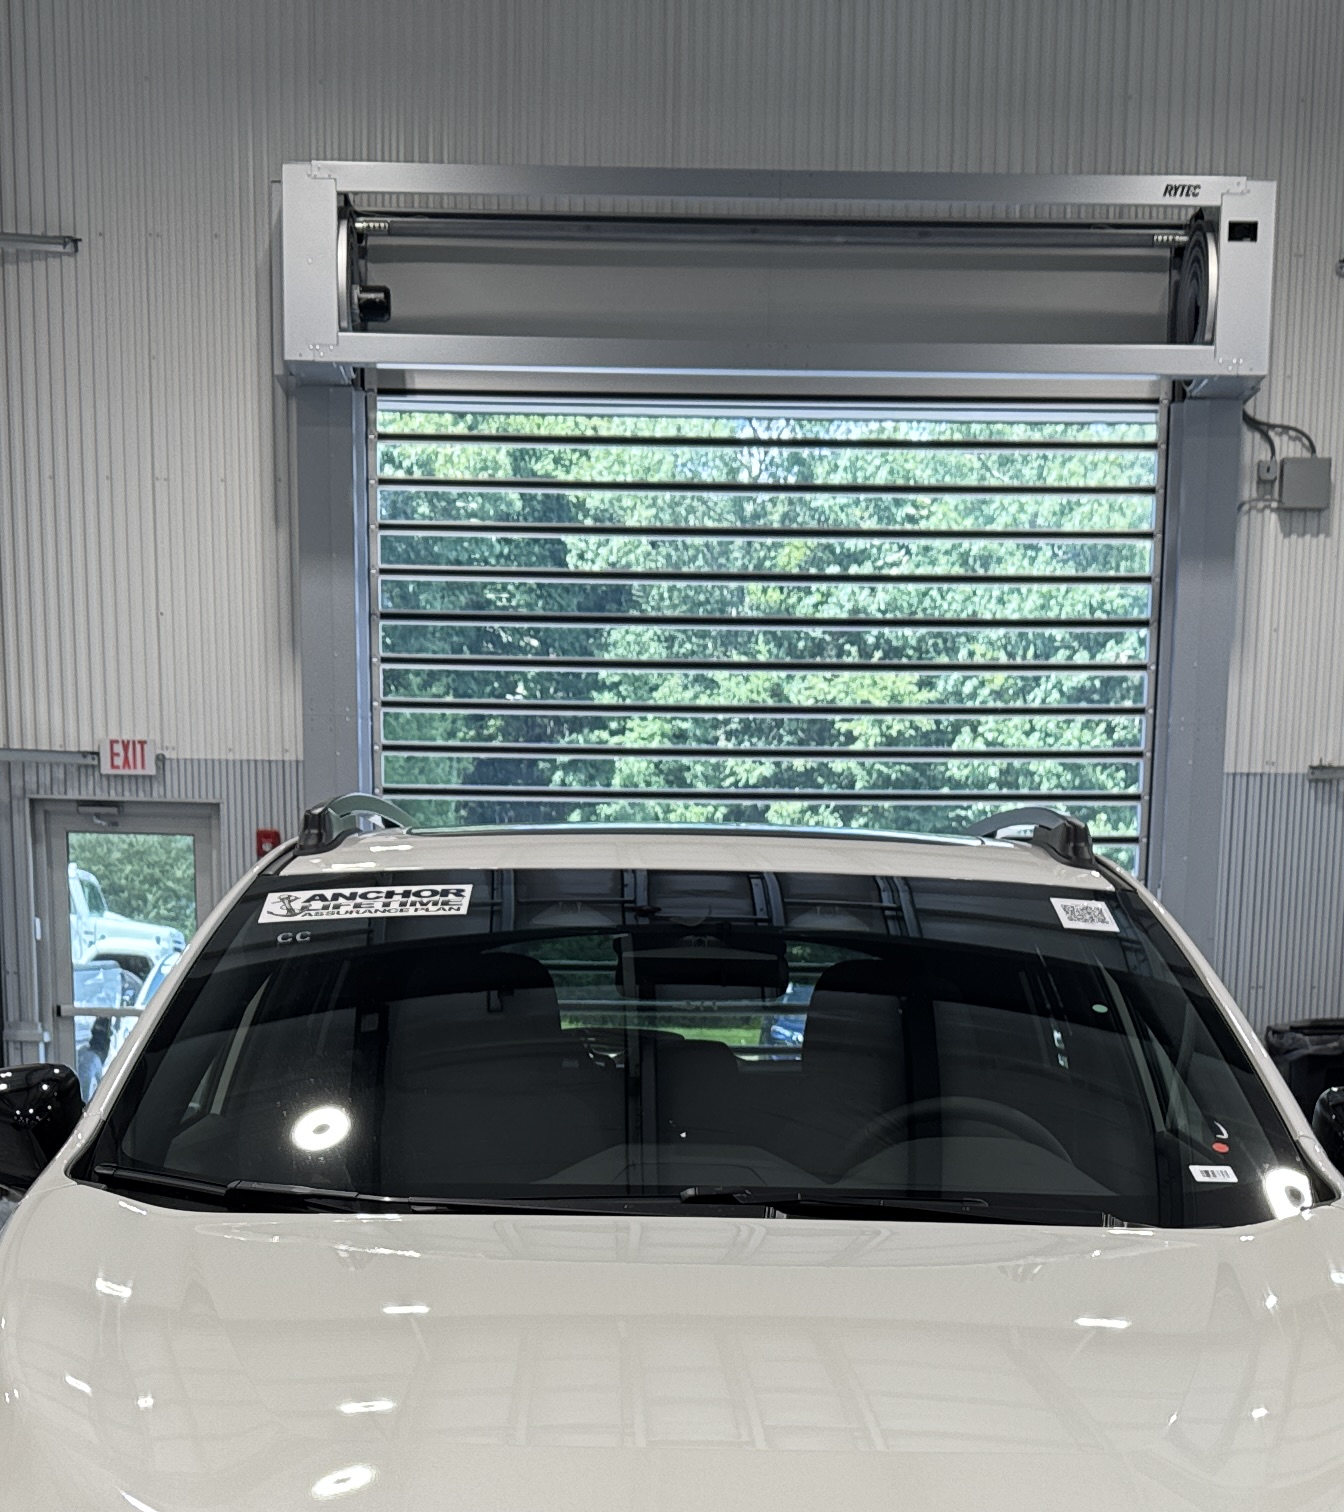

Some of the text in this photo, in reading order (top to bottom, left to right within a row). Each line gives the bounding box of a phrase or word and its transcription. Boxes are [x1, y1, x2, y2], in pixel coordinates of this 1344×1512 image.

[1163, 184, 1201, 197] RYTEC
[110, 739, 147, 769] EXIT
[301, 889, 466, 903] ANCHOR
[301, 899, 463, 912] LIFETIME
[301, 908, 410, 917] ASSURANCE
